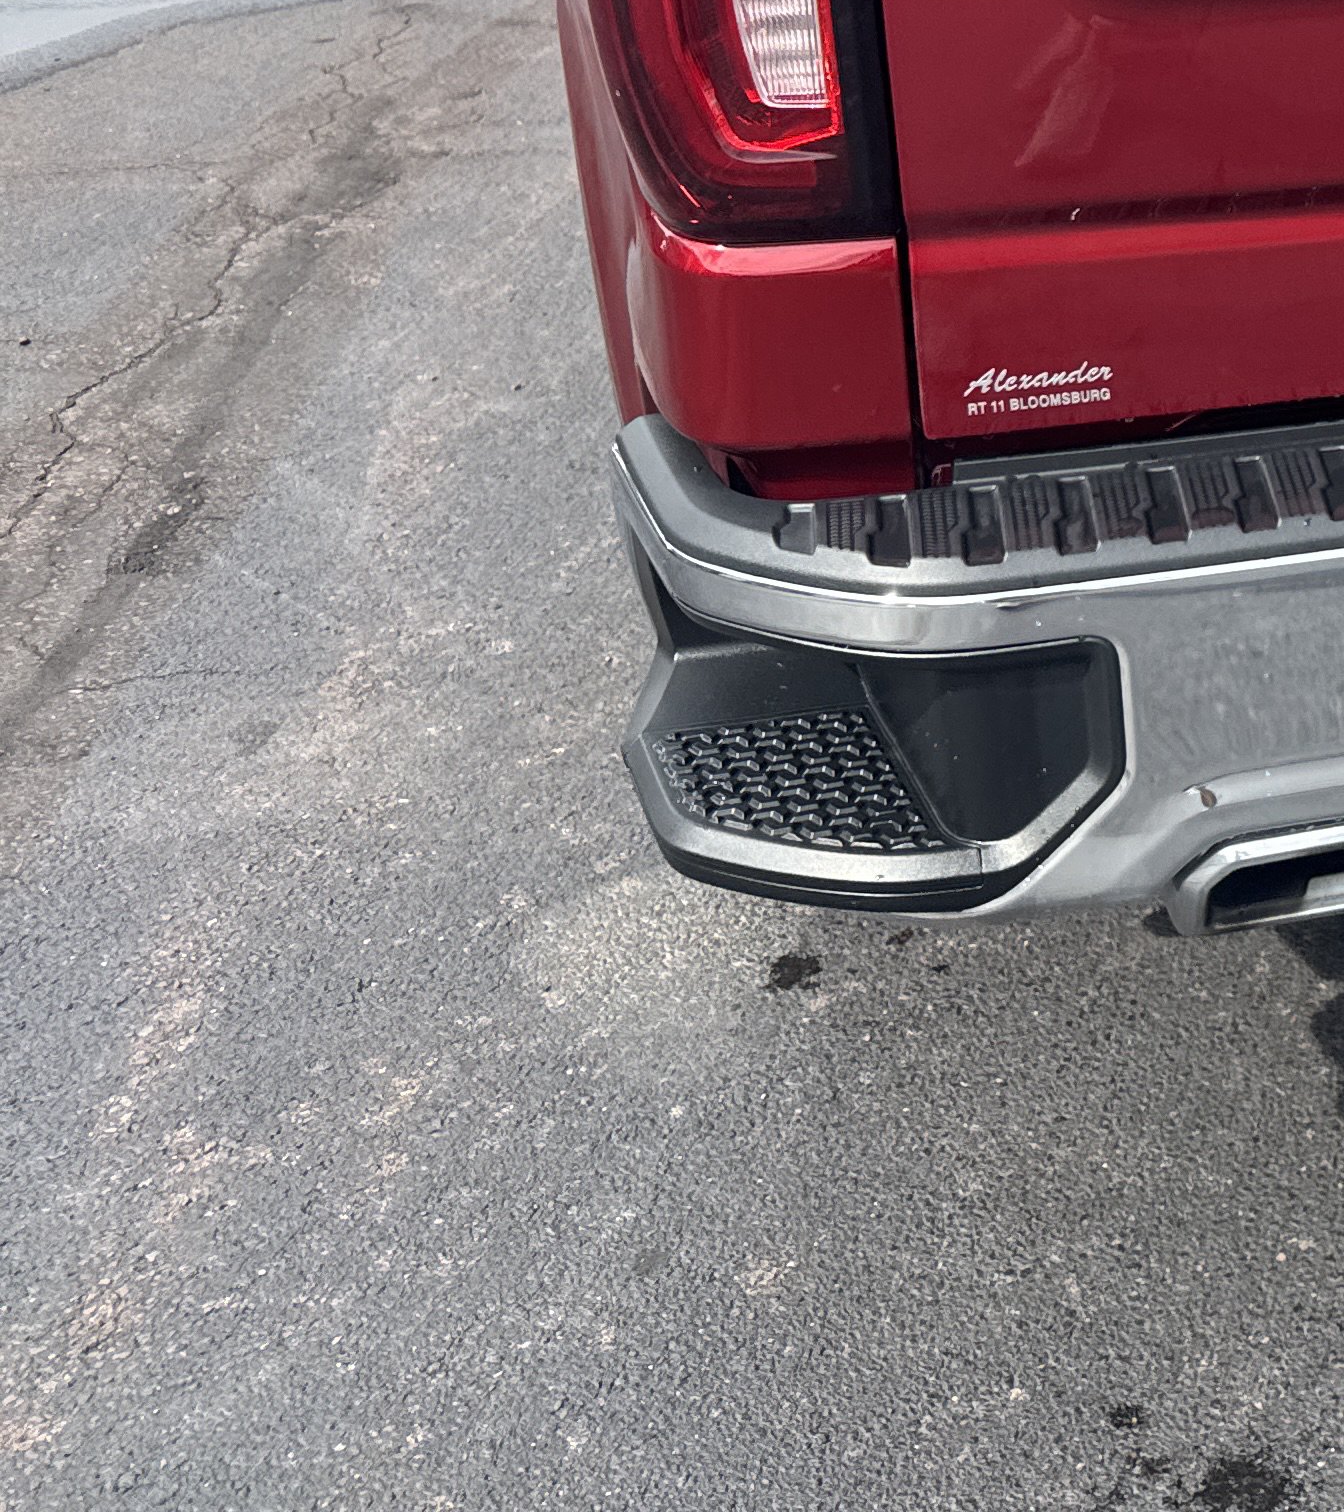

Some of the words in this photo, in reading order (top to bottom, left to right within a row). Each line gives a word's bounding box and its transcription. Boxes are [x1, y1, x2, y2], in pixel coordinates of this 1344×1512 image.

[963, 360, 1114, 397] Alexander
[967, 401, 987, 416] RT
[991, 399, 1006, 414] 11
[1009, 387, 1110, 412] BLOOMSBURG
